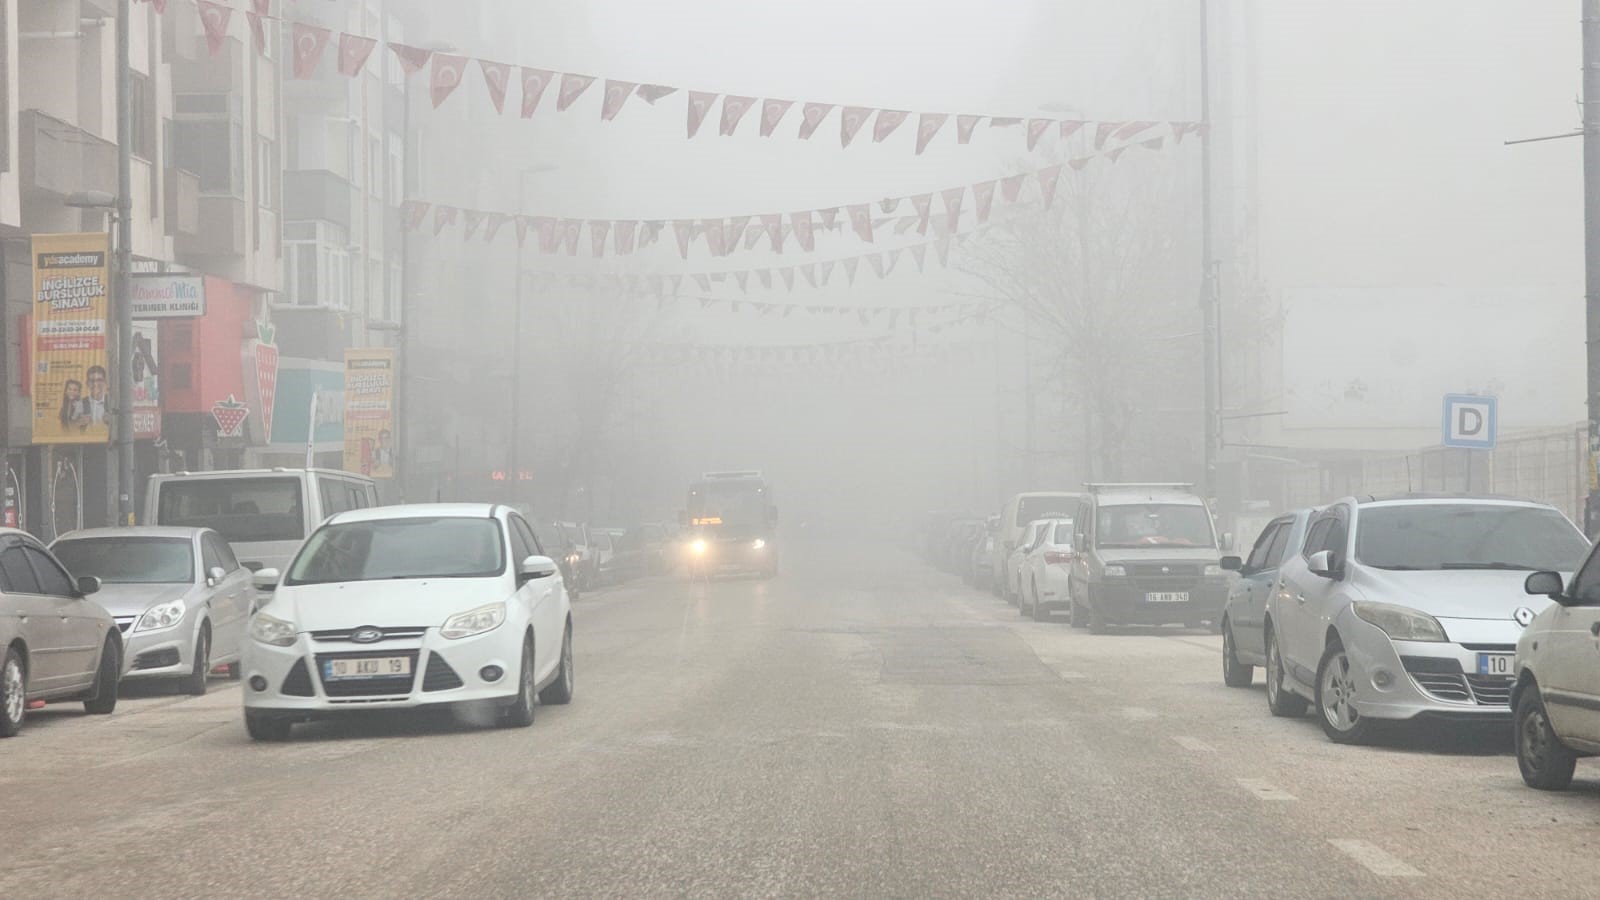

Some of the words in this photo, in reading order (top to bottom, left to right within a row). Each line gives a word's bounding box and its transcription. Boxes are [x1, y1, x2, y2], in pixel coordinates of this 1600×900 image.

[37, 285, 104, 302] BURSLULUK
[1459, 407, 1482, 435] D
[1491, 657, 1506, 673] 10
